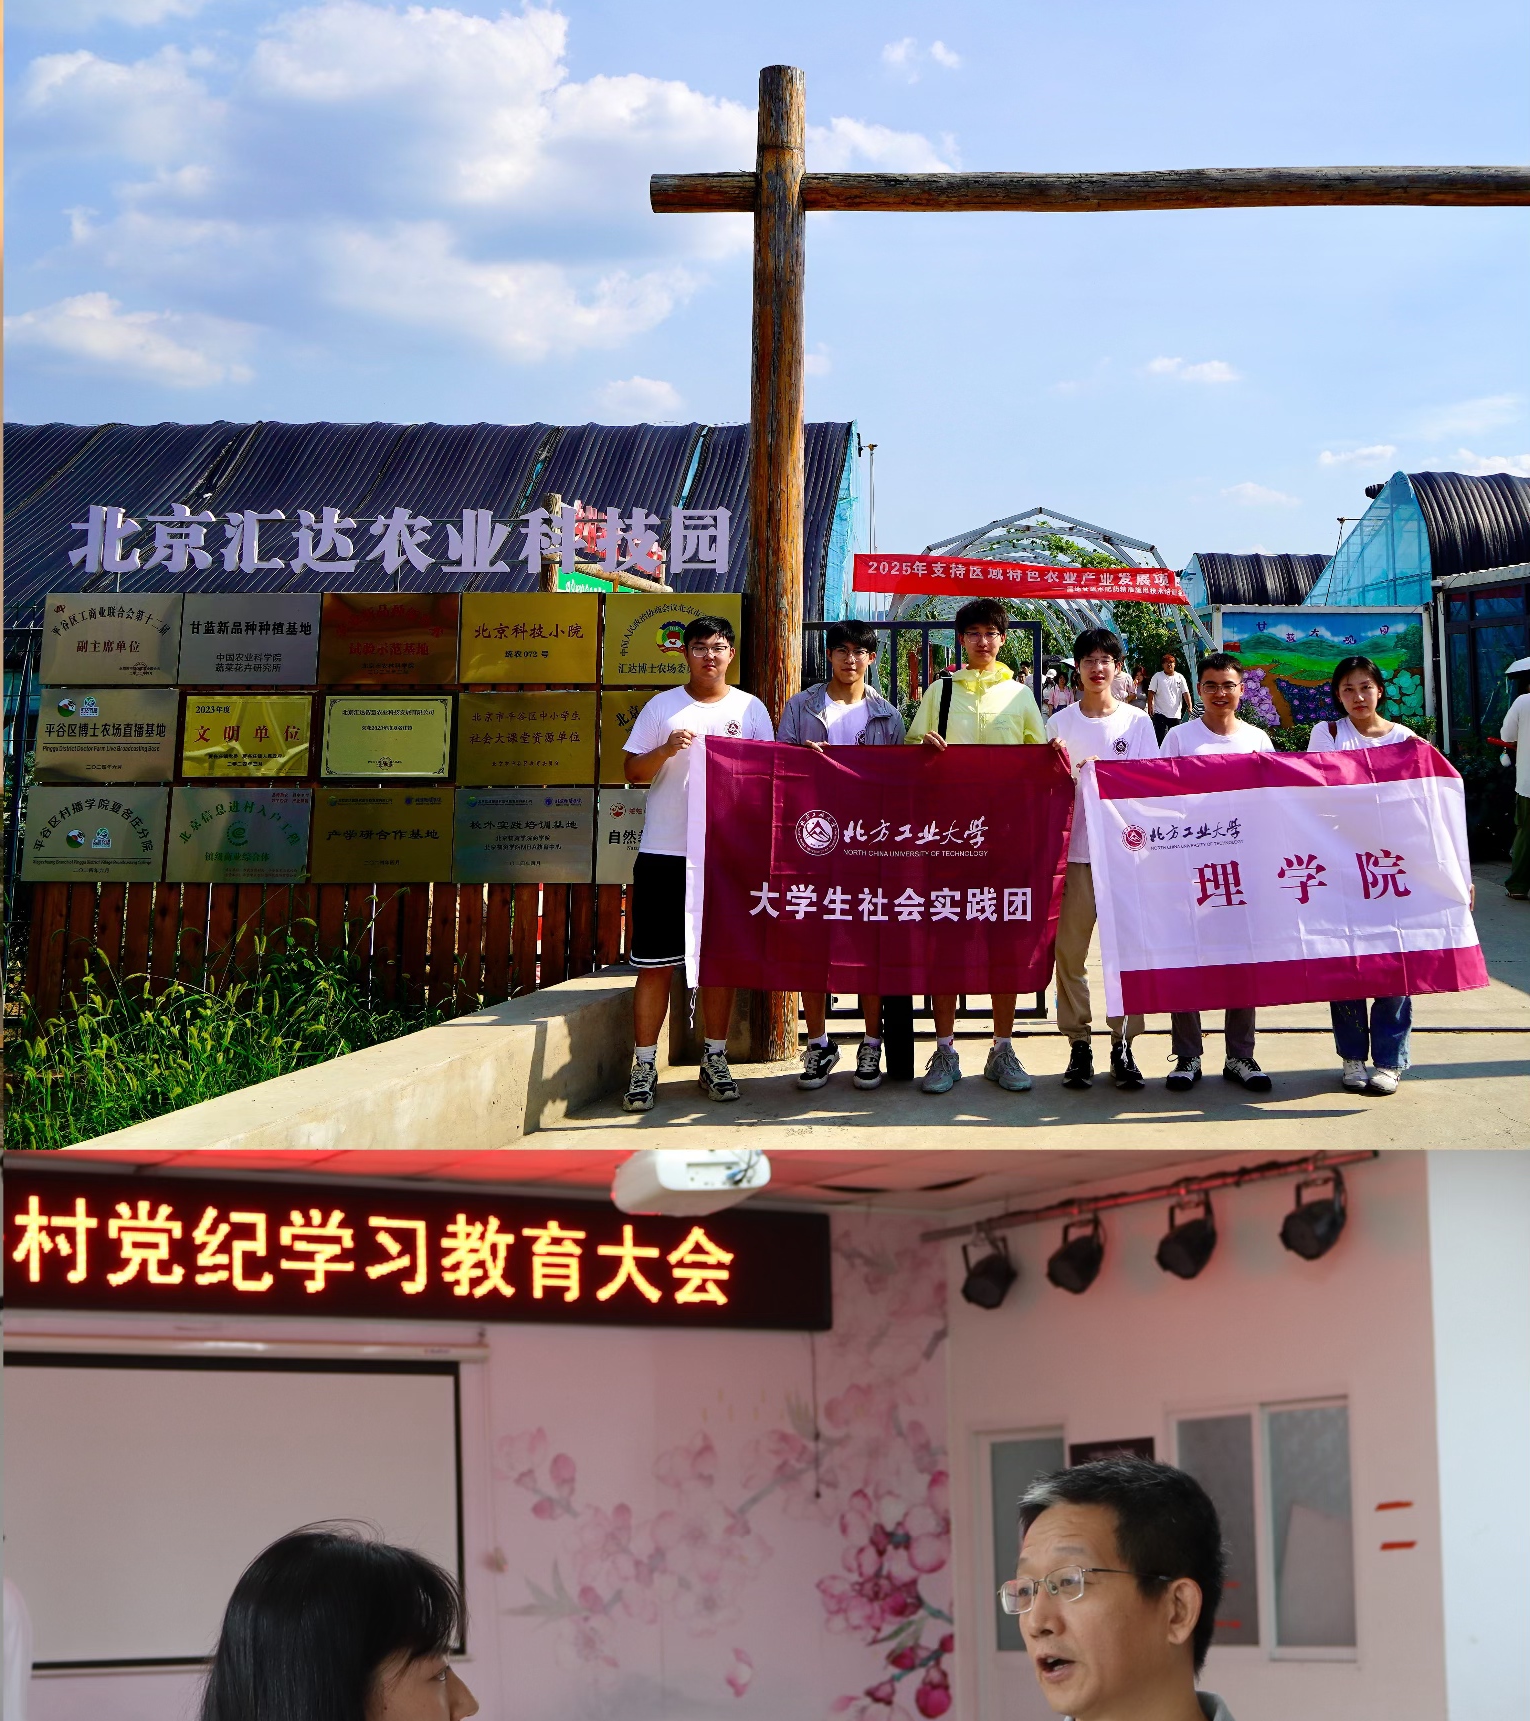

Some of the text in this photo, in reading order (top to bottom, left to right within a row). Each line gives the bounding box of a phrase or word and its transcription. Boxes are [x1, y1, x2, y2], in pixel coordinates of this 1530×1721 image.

[67, 502, 732, 575] 北京汇达农业科技园
[50, 605, 171, 637] 平谷区工商业联合会第十二届
[190, 620, 312, 635] 甘蓝新品种种植基地
[474, 622, 584, 640] 北京科技小院
[76, 640, 140, 653] 副主席单位
[348, 642, 429, 656] 试验示范基地
[216, 652, 282, 662] 中国农业科学院
[215, 663, 281, 673] 蔬菜花卉研究所
[195, 705, 231, 714] 2023年度
[471, 711, 581, 722] 北京市平谷区中小学生
[44, 722, 166, 738] 平谷区博士农场直播基地
[193, 725, 301, 743] 文明单位
[469, 731, 581, 744] 社会大课堂资源单位
[32, 798, 154, 853] 平谷区村播学院夏各庄分院
[178, 800, 301, 847] 北京信息进村入户工程
[469, 820, 578, 830] 校外实践培训基地
[843, 815, 989, 848] 北方工业大学
[1149, 817, 1242, 842] 北方工业大学
[326, 829, 440, 841] 产学研合作基地
[843, 849, 867, 857] NORTH
[868, 849, 889, 858] CHINA
[889, 850, 930, 858] UNIVERSITY
[942, 850, 989, 858] TECHNOLOGY
[1193, 848, 1412, 908] 理学院
[749, 884, 1033, 922] 大学生社会实践团
[13, 1194, 736, 1306] 村党纪学习教育大会
